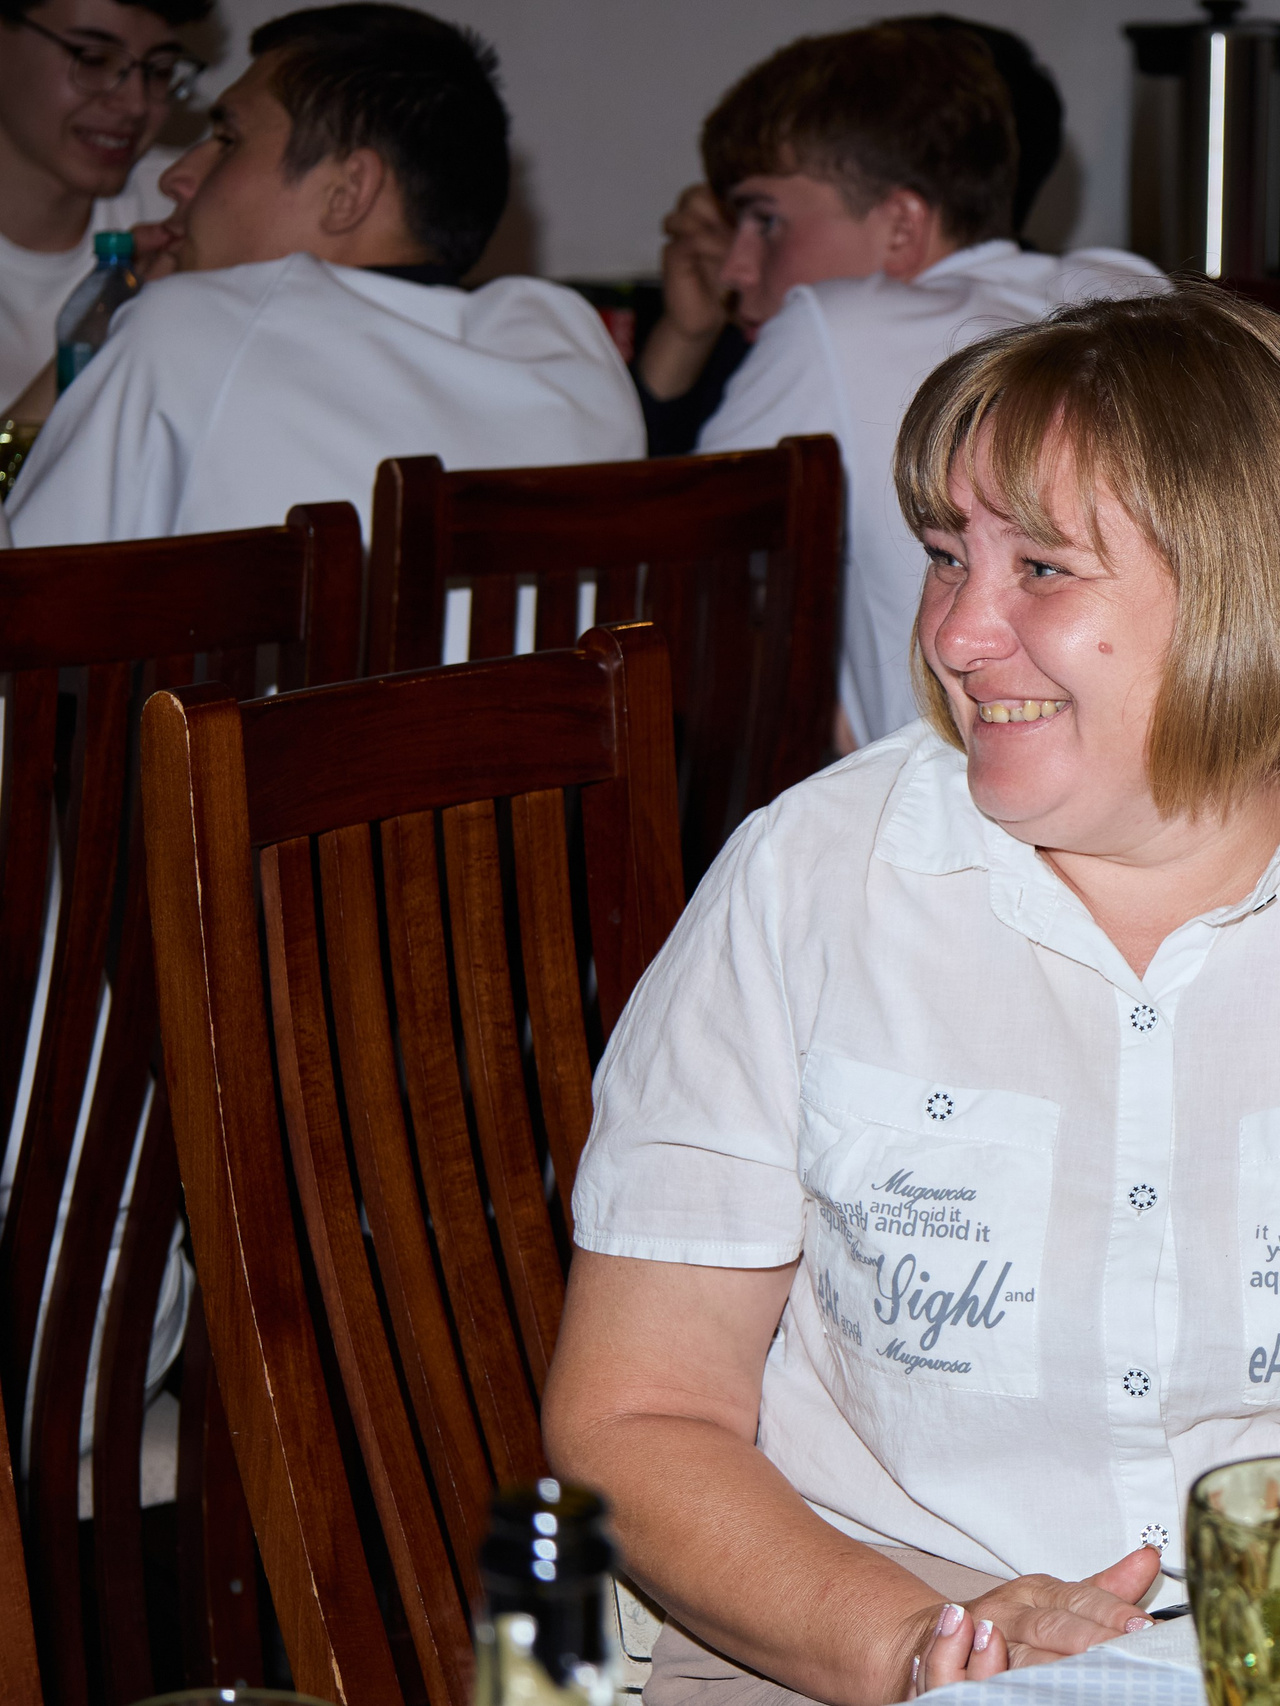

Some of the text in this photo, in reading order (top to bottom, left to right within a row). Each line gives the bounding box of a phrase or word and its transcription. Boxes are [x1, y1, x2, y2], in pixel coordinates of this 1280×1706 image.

[869, 1201, 903, 1219] and
[949, 1206, 962, 1223] it
[874, 1214, 918, 1238] and
[975, 1221, 992, 1243] it
[1255, 1224, 1269, 1241] it
[1004, 1287, 1035, 1302] and
